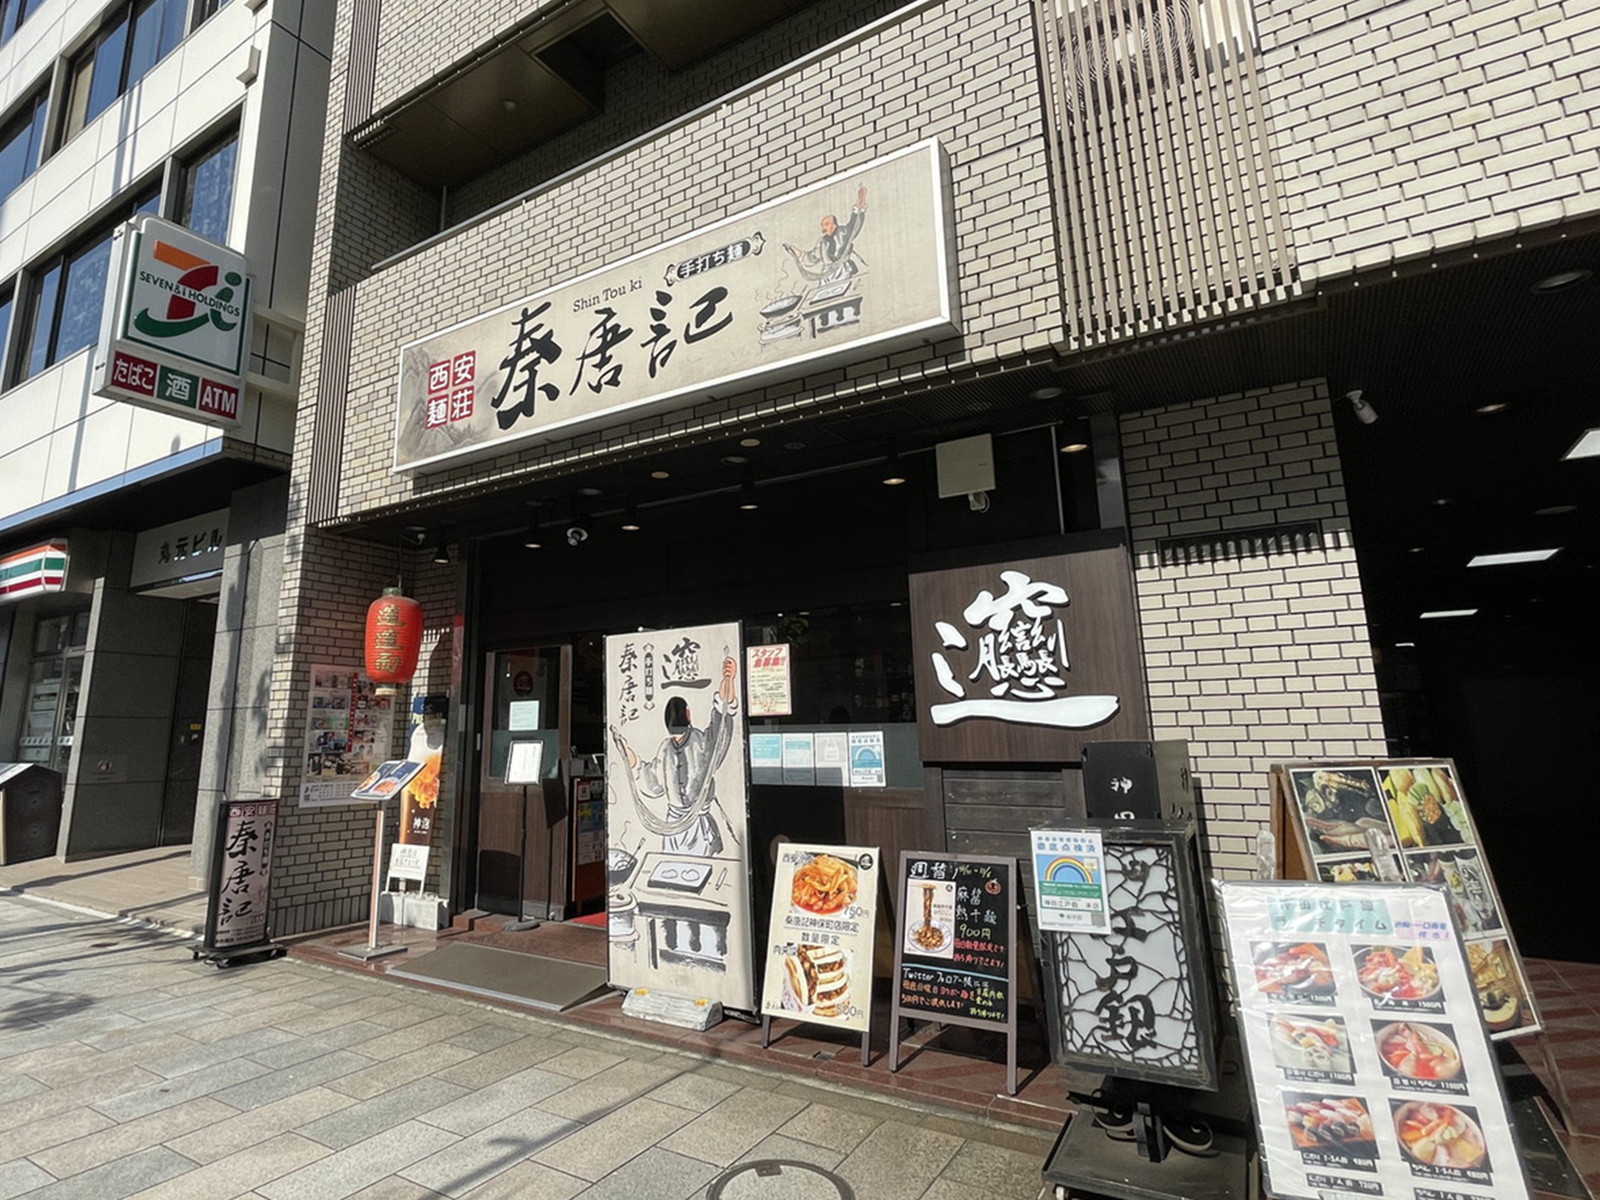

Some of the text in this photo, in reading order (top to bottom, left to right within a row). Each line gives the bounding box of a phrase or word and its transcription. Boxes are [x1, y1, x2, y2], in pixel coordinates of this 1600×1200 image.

[679, 243, 744, 279] 手打ち麺
[188, 289, 241, 317] HOLDINGS
[572, 275, 643, 313] Shin Tou ki
[113, 357, 153, 390] たばこ
[492, 287, 734, 430] 秦唐記
[165, 372, 192, 401] 酒
[201, 384, 237, 415] ATM
[618, 642, 640, 727] 秦唐記
[220, 820, 259, 927] 秦唐記
[959, 923, 991, 940] 900円
[902, 967, 935, 981] Twitter
